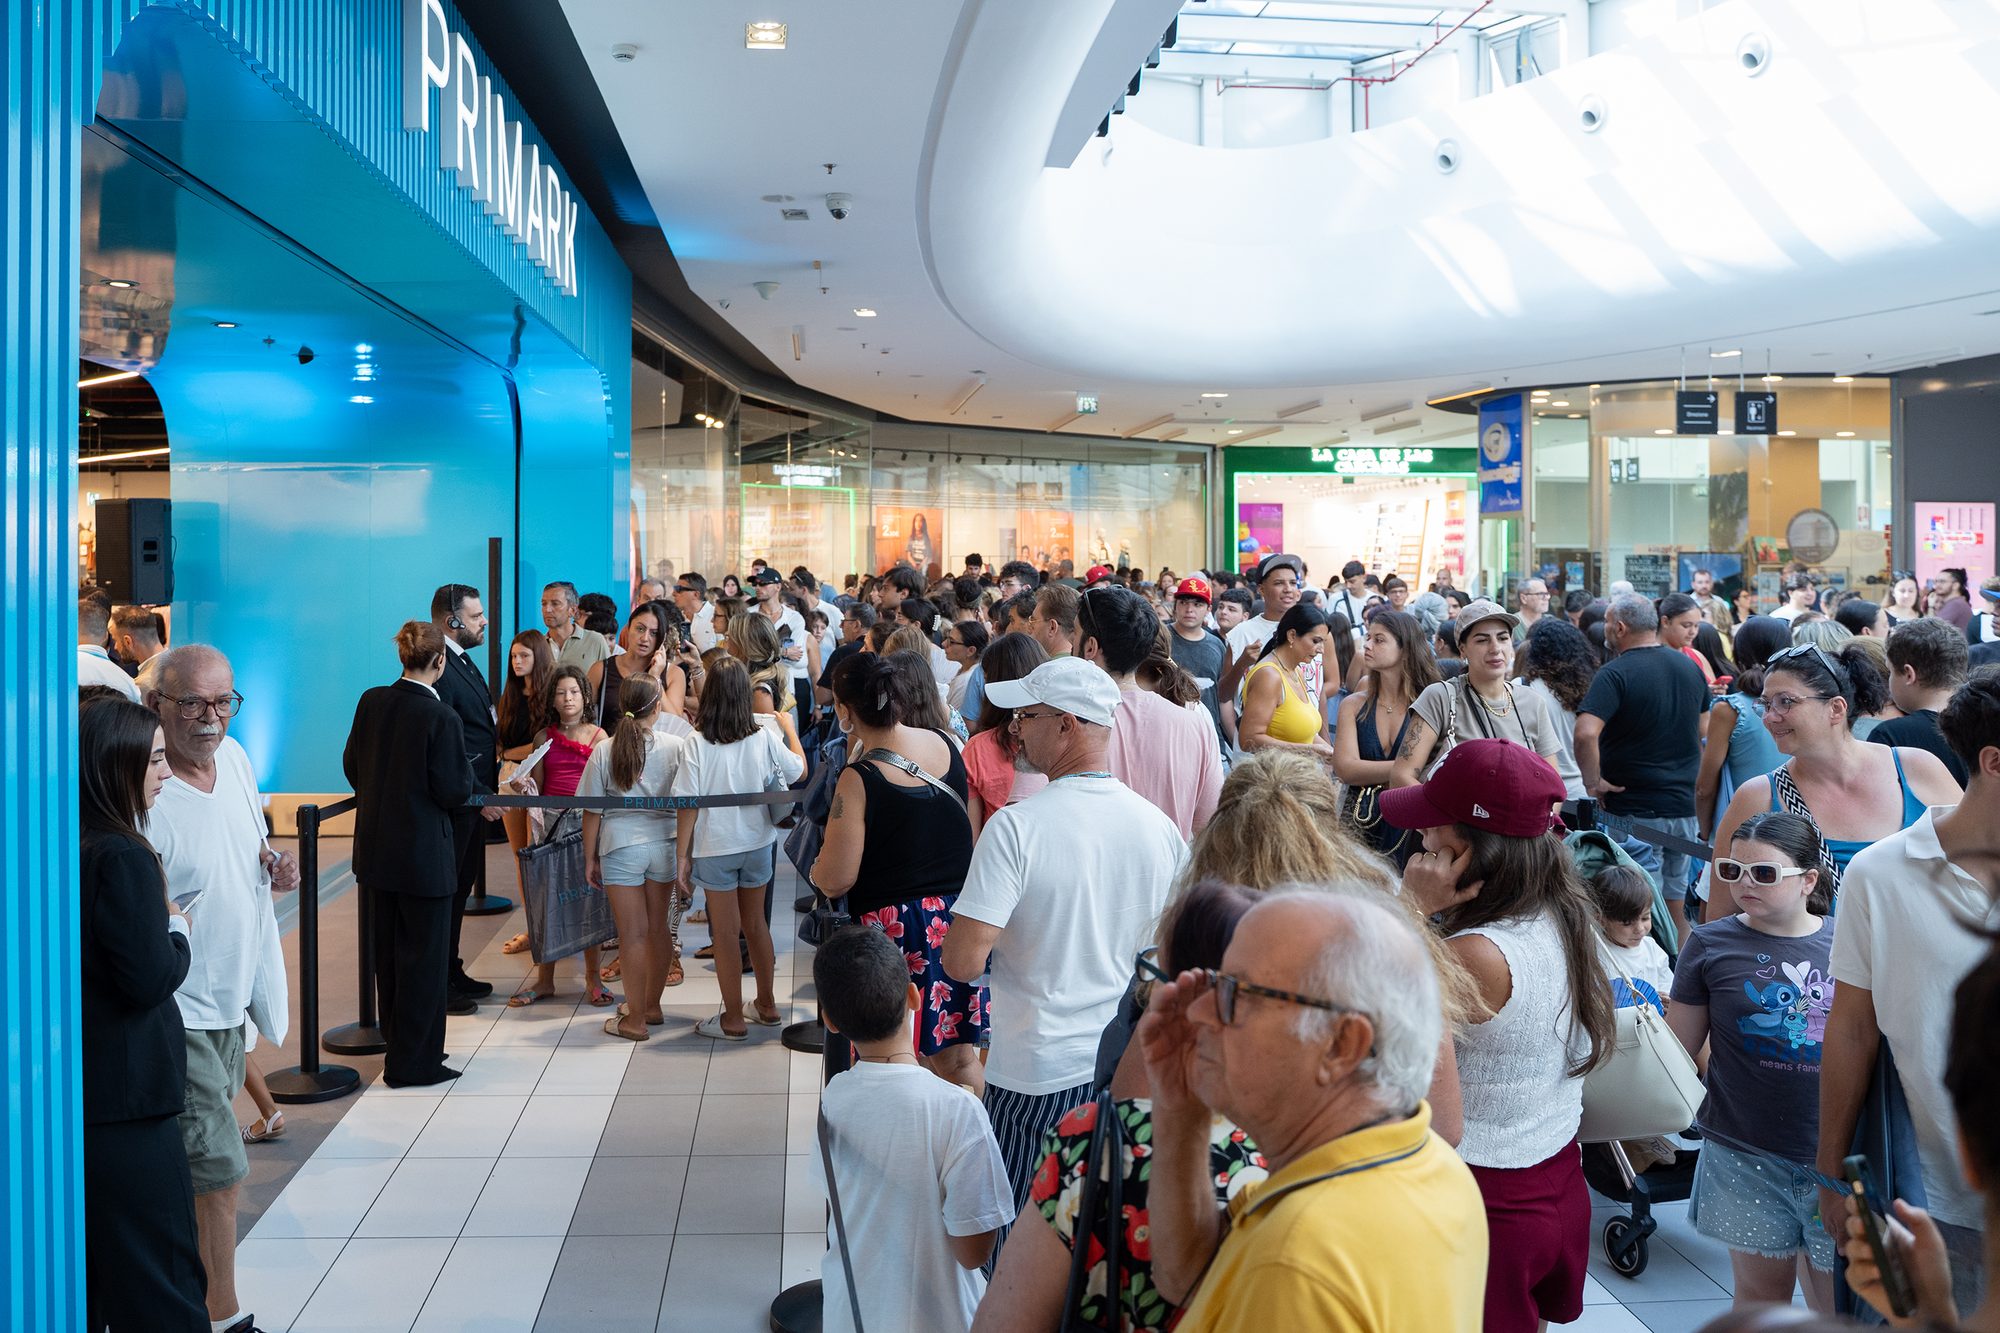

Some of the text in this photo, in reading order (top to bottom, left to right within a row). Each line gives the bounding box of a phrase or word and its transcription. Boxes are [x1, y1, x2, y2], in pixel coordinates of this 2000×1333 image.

[421, 0, 578, 298] PRIMARK
[1312, 448, 1334, 461] LA
[1337, 448, 1377, 463] CASA
[624, 797, 699, 809] PRIMARK
[1759, 1060, 1821, 1073] means fami
